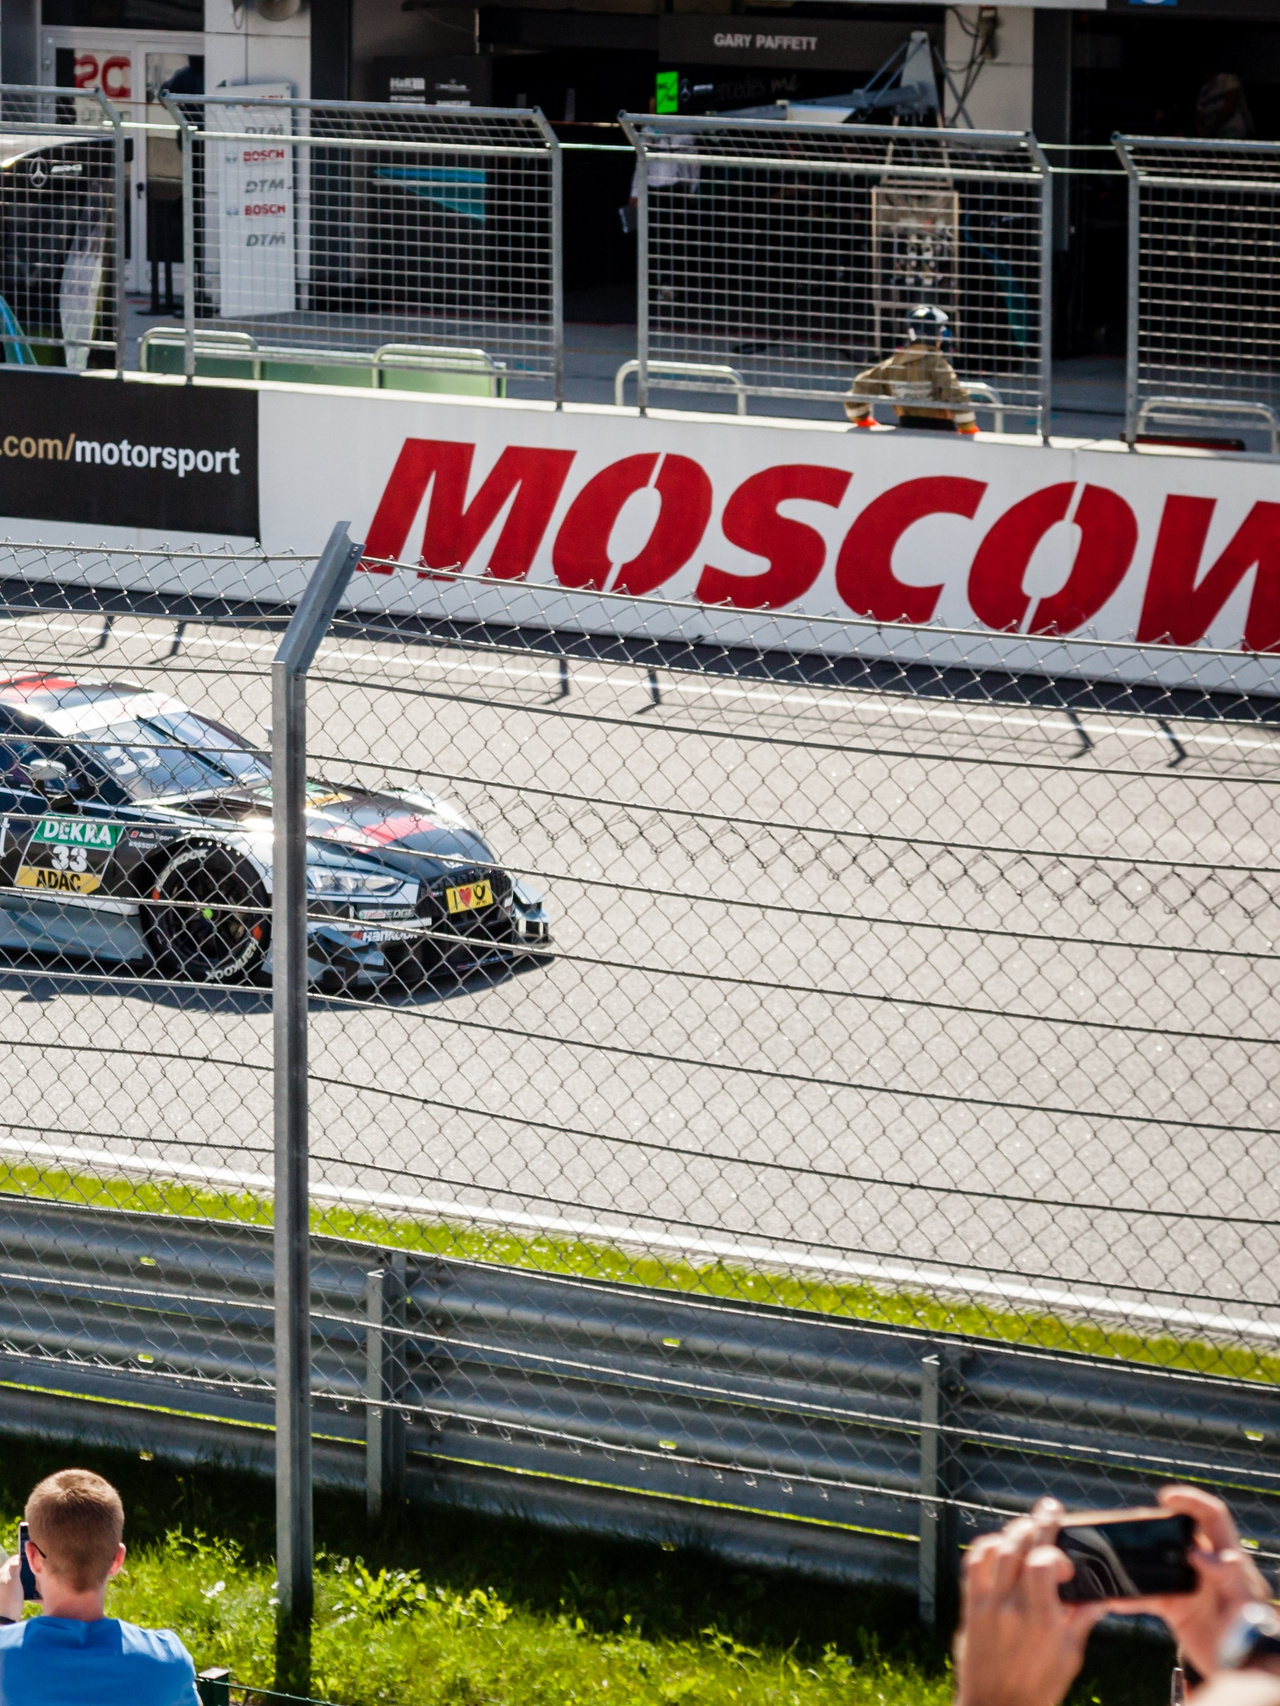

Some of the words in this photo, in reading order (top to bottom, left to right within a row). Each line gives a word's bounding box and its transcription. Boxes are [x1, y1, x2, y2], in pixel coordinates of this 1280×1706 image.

[713, 33, 752, 47] GARY
[755, 36, 818, 50] PAFFETT
[242, 150, 285, 163] BOSCH
[244, 178, 285, 194] DTM
[244, 204, 286, 217] BOSCH
[246, 233, 287, 248] DTM
[357, 437, 1280, 652] MOSCOW
[43, 820, 112, 845] DEKRA
[51, 845, 88, 873] 33
[36, 869, 82, 891] ADAC
